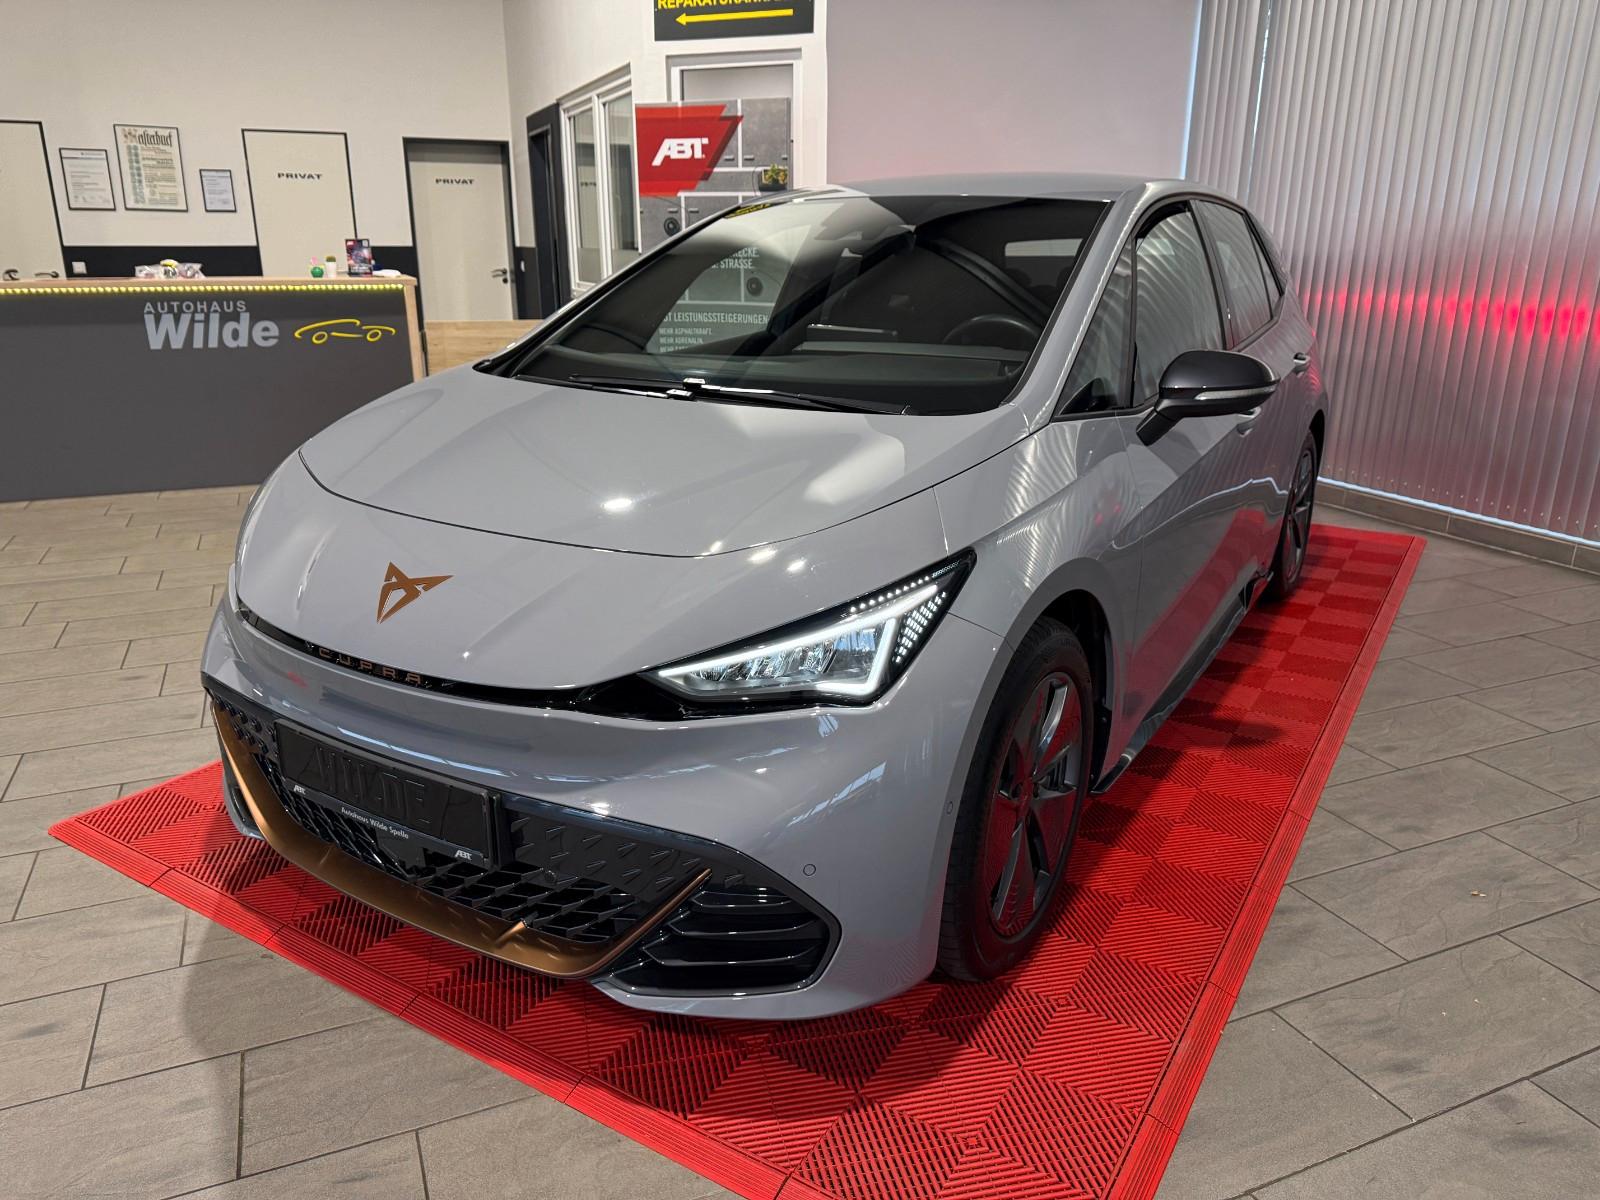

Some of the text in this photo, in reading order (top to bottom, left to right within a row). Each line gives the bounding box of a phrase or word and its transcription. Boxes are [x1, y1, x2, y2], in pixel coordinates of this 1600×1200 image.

[651, 136, 709, 167] ABT
[277, 172, 323, 180] PRIVAT
[143, 300, 247, 313] AUTOHAUS
[673, 312, 769, 324] LEISTUNGSSTEIGERUNGEN
[143, 312, 280, 350] Wilde
[318, 647, 422, 687] CUPRA
[369, 818, 388, 831] Wilde
[454, 849, 473, 861] ABT
